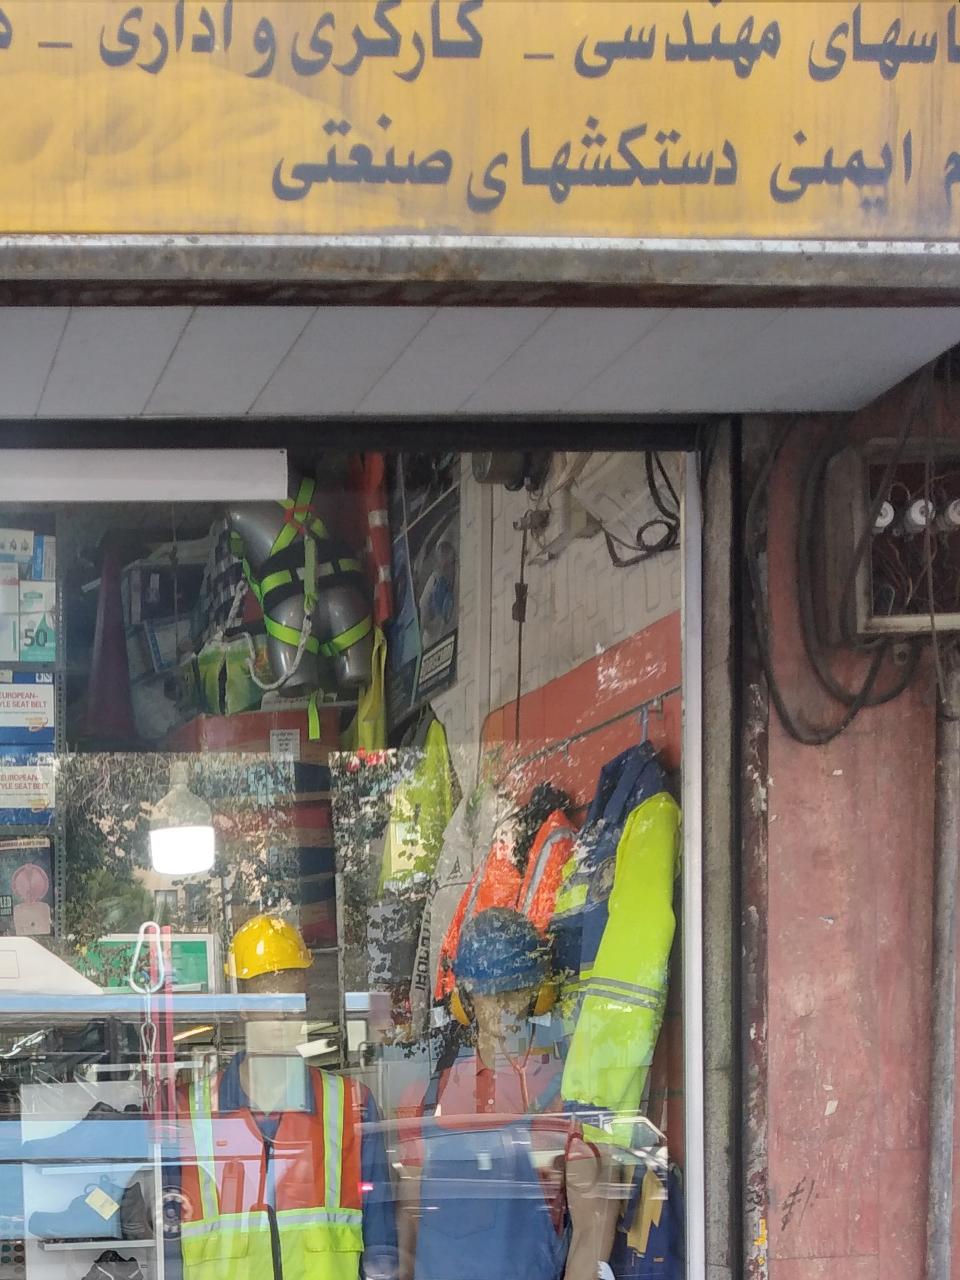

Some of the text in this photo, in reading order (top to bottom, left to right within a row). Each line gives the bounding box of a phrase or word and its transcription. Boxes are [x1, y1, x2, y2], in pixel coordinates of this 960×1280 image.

[100, 0, 234, 74] اداری
[246, 15, 277, 78] و
[574, 0, 781, 79] مهندسی
[271, 113, 454, 201] صنعتی
[769, 128, 913, 208] ایمنی
[24, 627, 48, 648] 50
